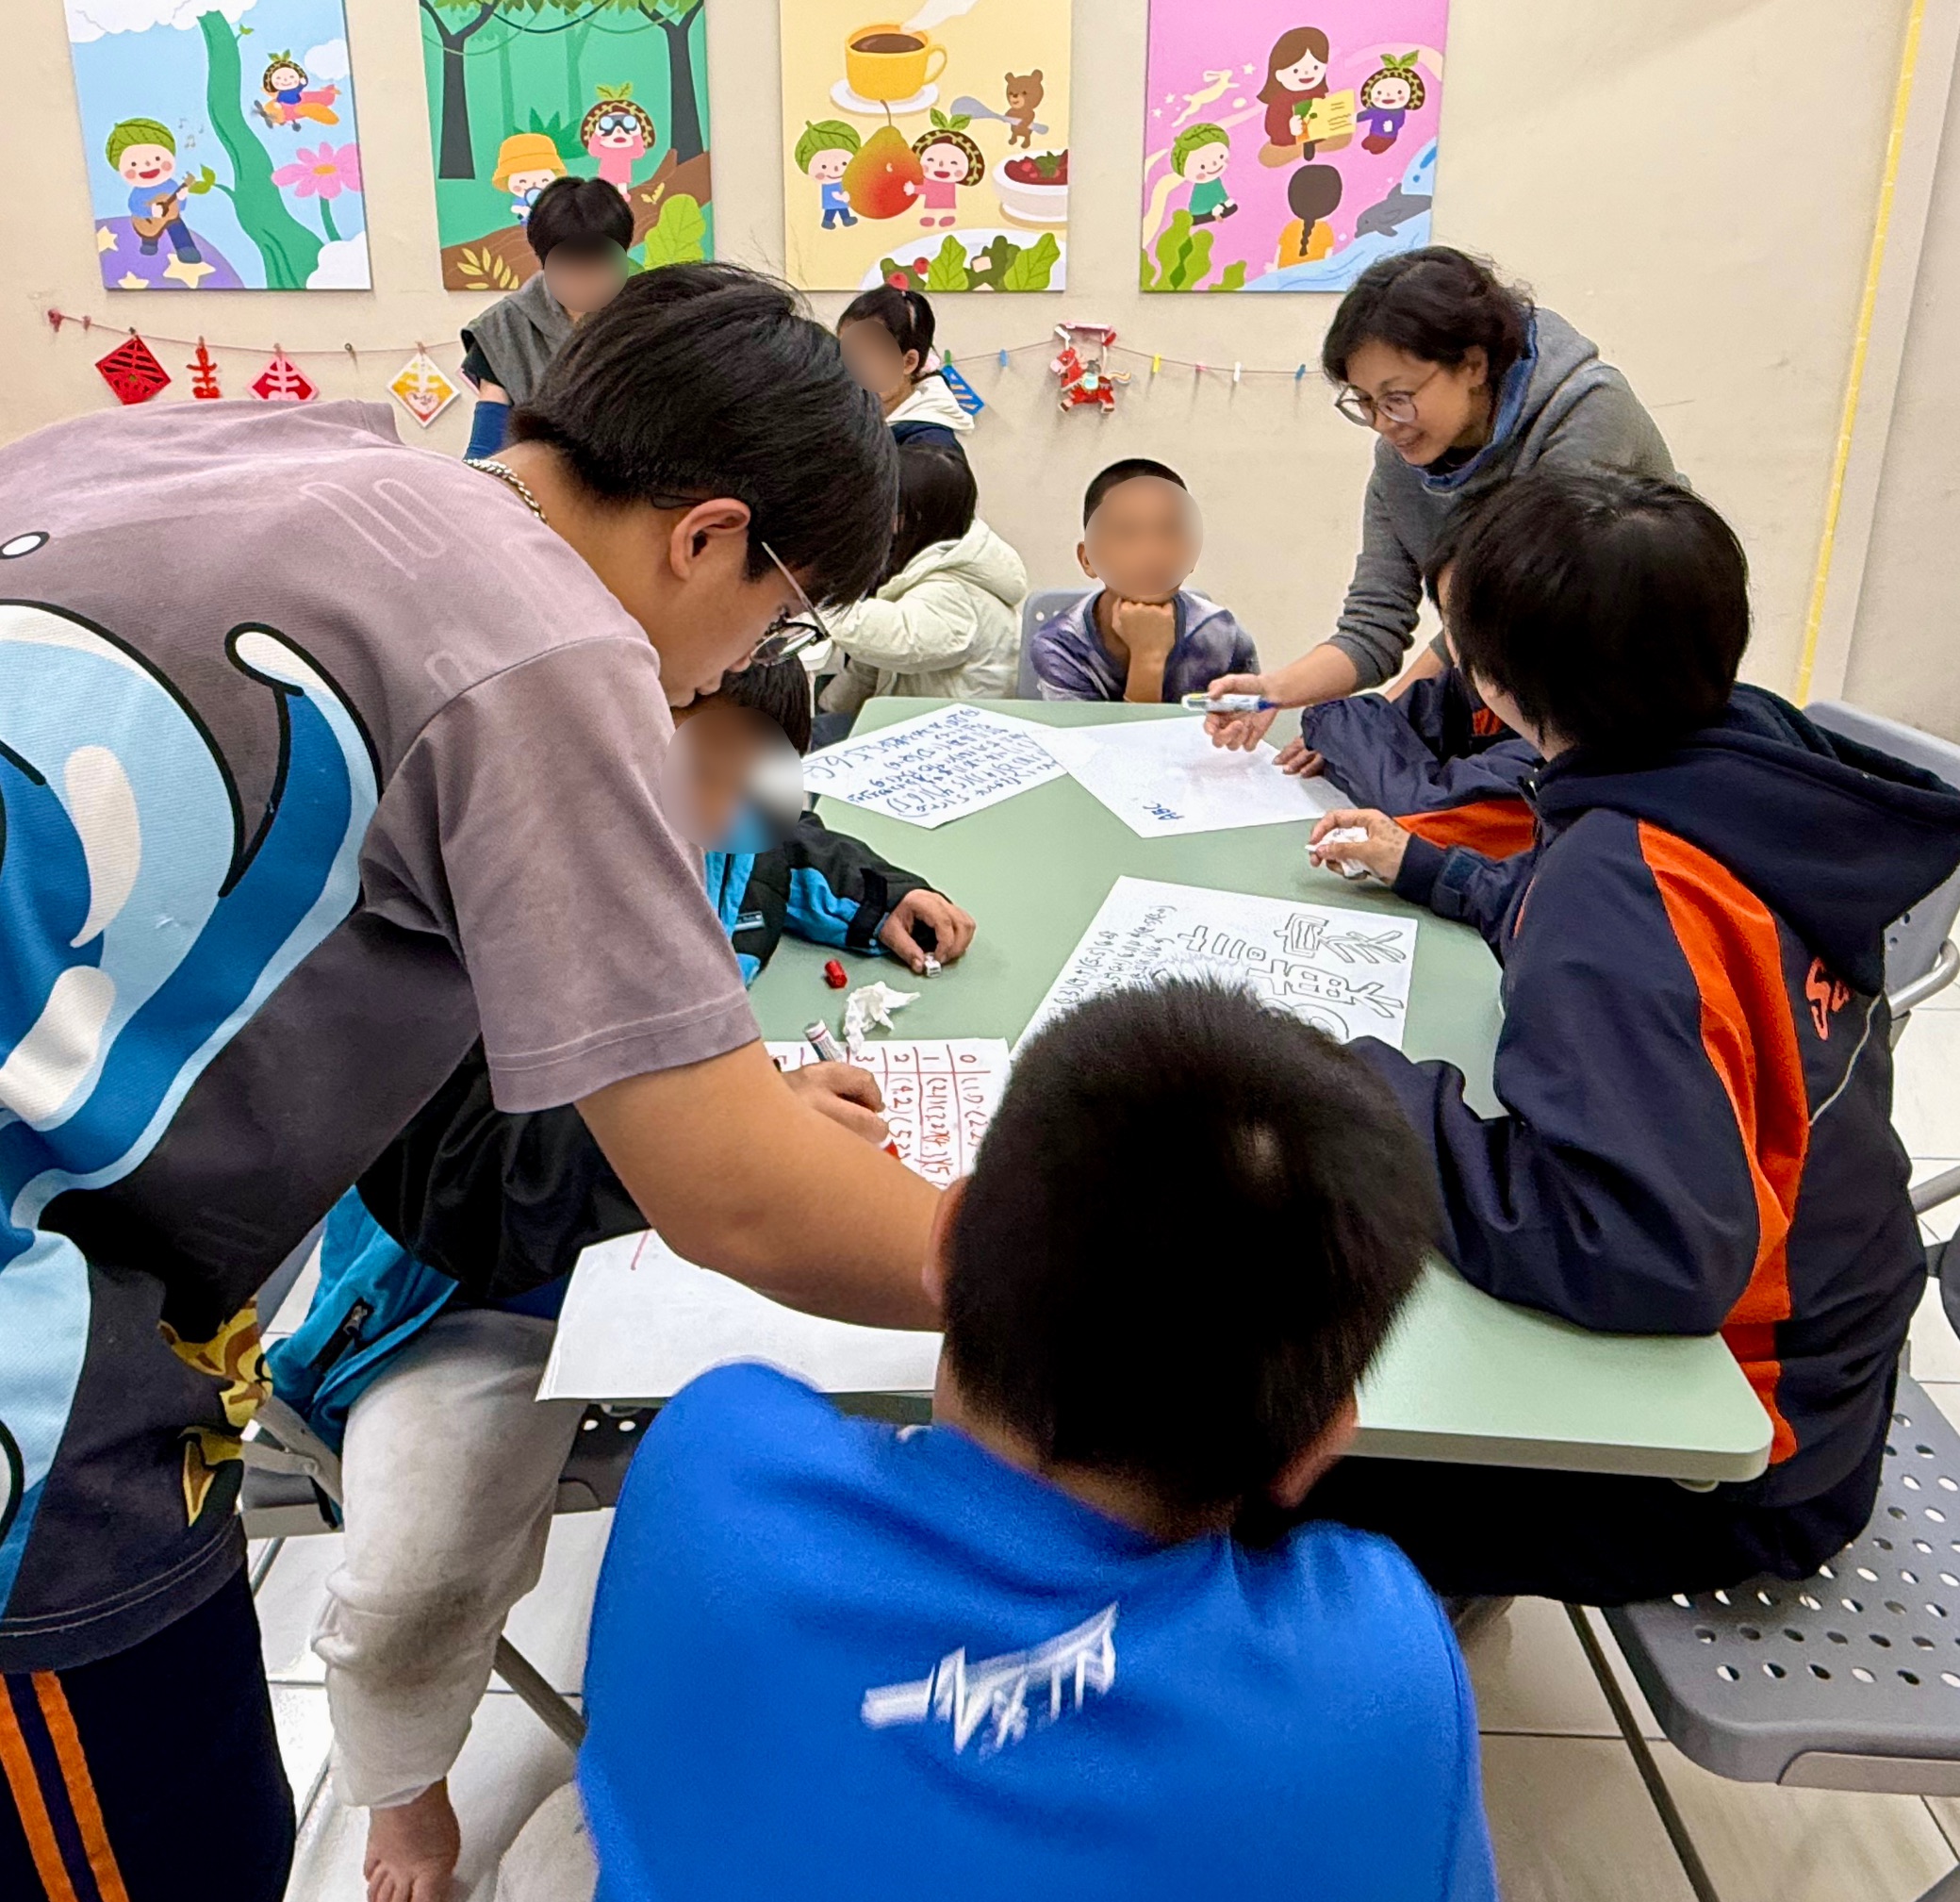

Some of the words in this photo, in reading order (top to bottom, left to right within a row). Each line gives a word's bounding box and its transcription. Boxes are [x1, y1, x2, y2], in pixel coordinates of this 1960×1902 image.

[1142, 802, 1185, 820] ABC
[894, 1053, 910, 1063] 2
[960, 1054, 977, 1063] 0
